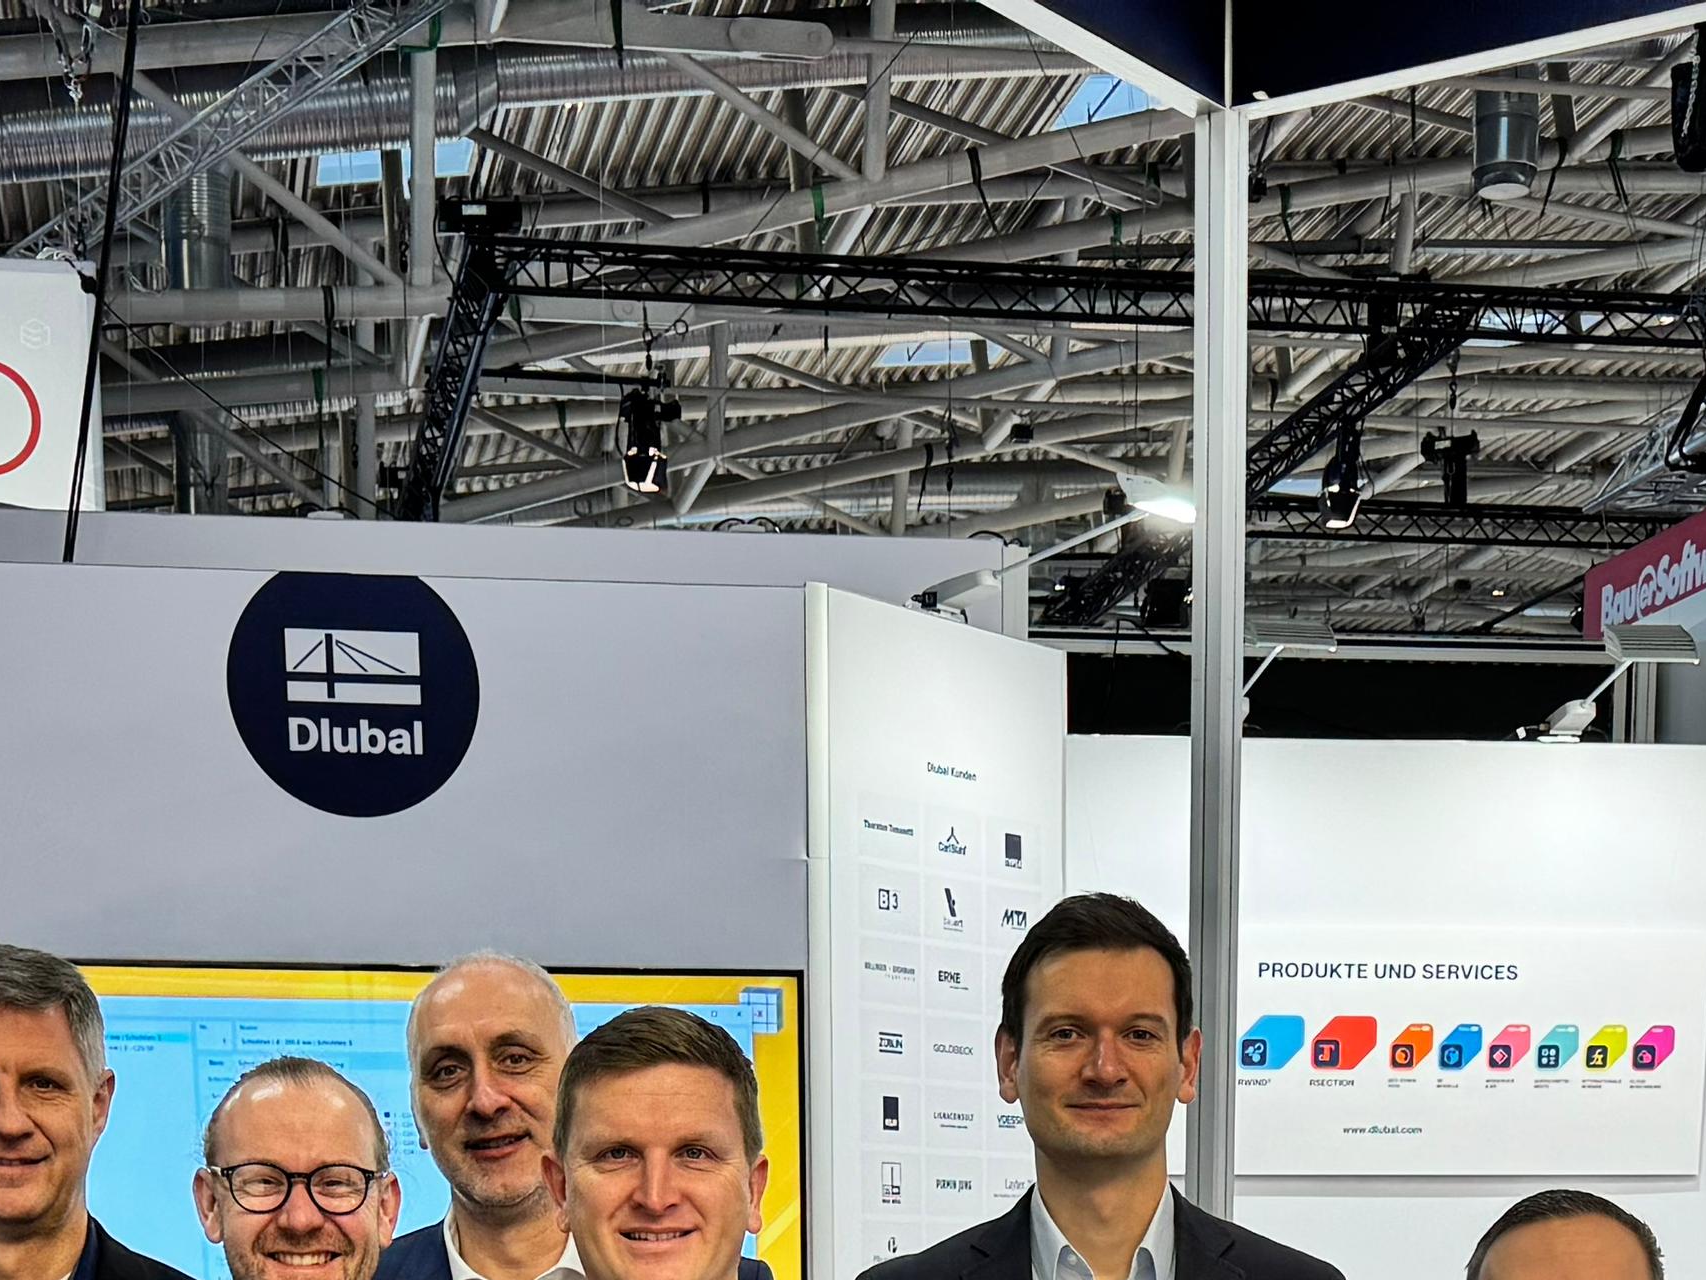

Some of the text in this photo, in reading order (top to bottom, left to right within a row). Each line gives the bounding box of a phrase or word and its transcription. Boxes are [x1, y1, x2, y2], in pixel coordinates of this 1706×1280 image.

[287, 716, 424, 755] Dlubal
[1258, 962, 1518, 981] PRODUKTE UND SERVICES
